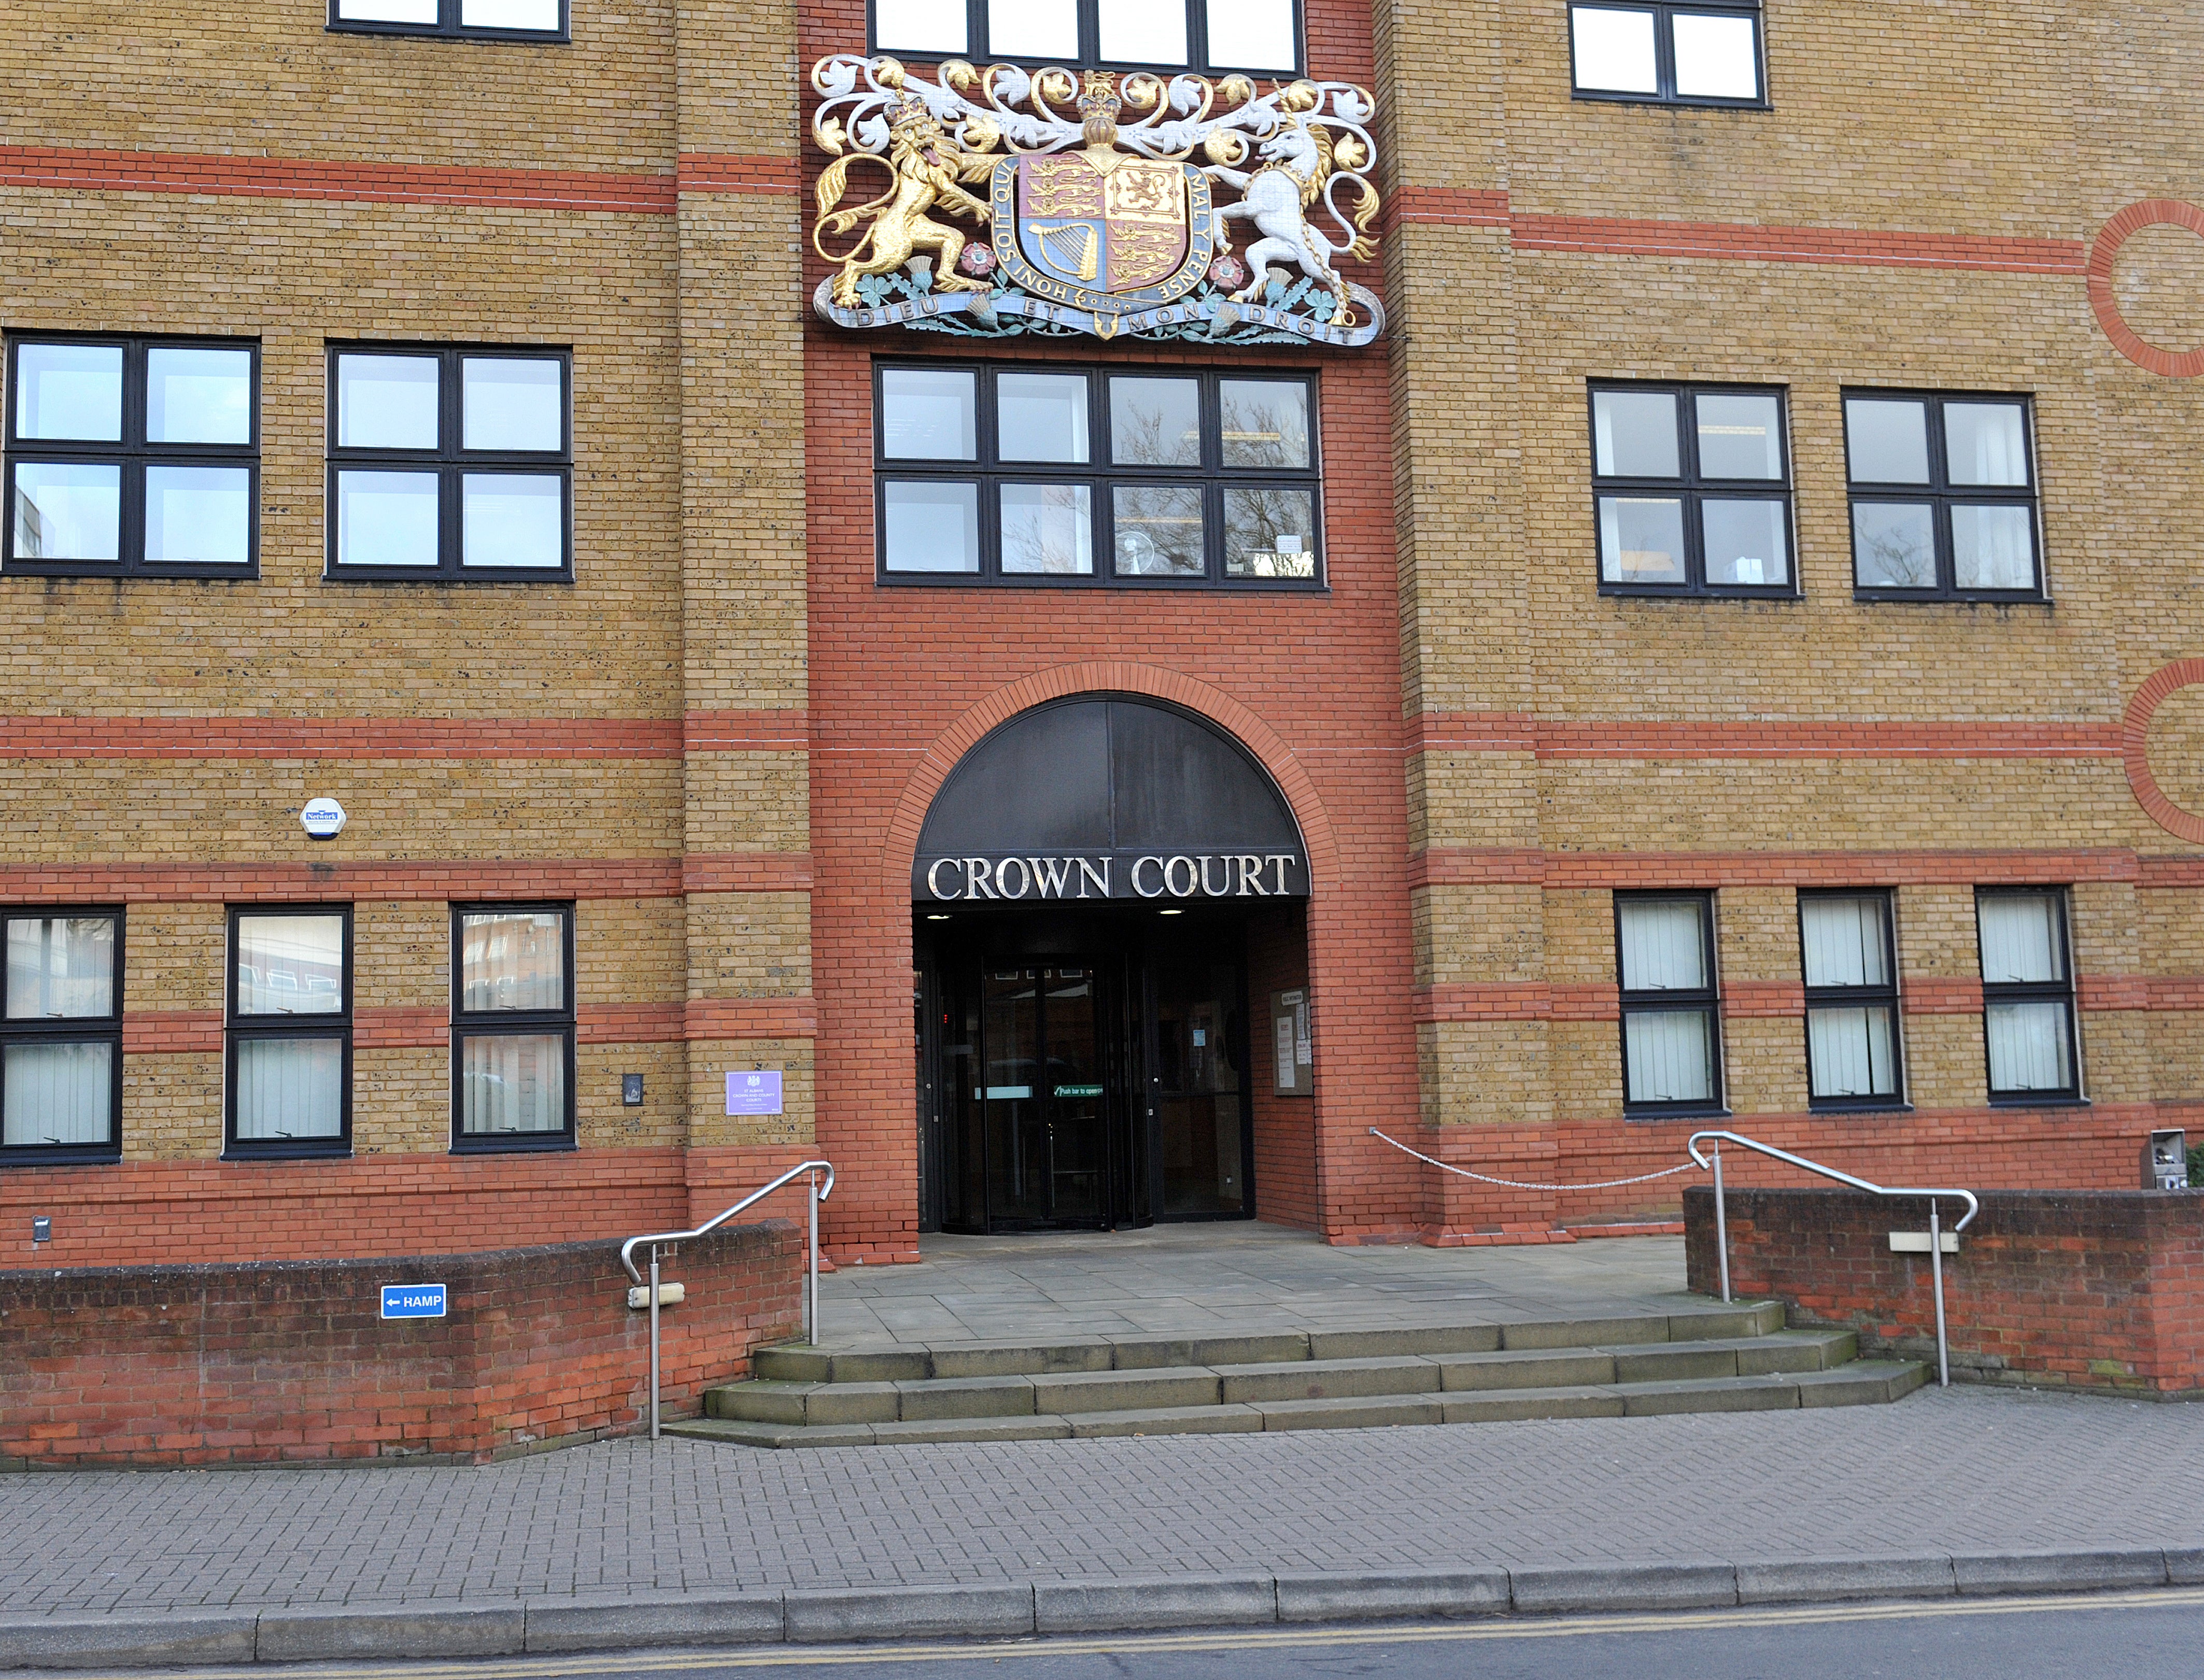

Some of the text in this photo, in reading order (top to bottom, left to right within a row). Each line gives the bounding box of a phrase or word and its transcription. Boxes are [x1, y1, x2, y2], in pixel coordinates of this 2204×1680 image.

[994, 161, 1209, 300] HONI SOIT QUI MAL Y PENSE
[856, 297, 1354, 344] DIEU ET MON DROIT
[927, 855, 1295, 900] CROWN COURT
[403, 1295, 442, 1307] RAMP
